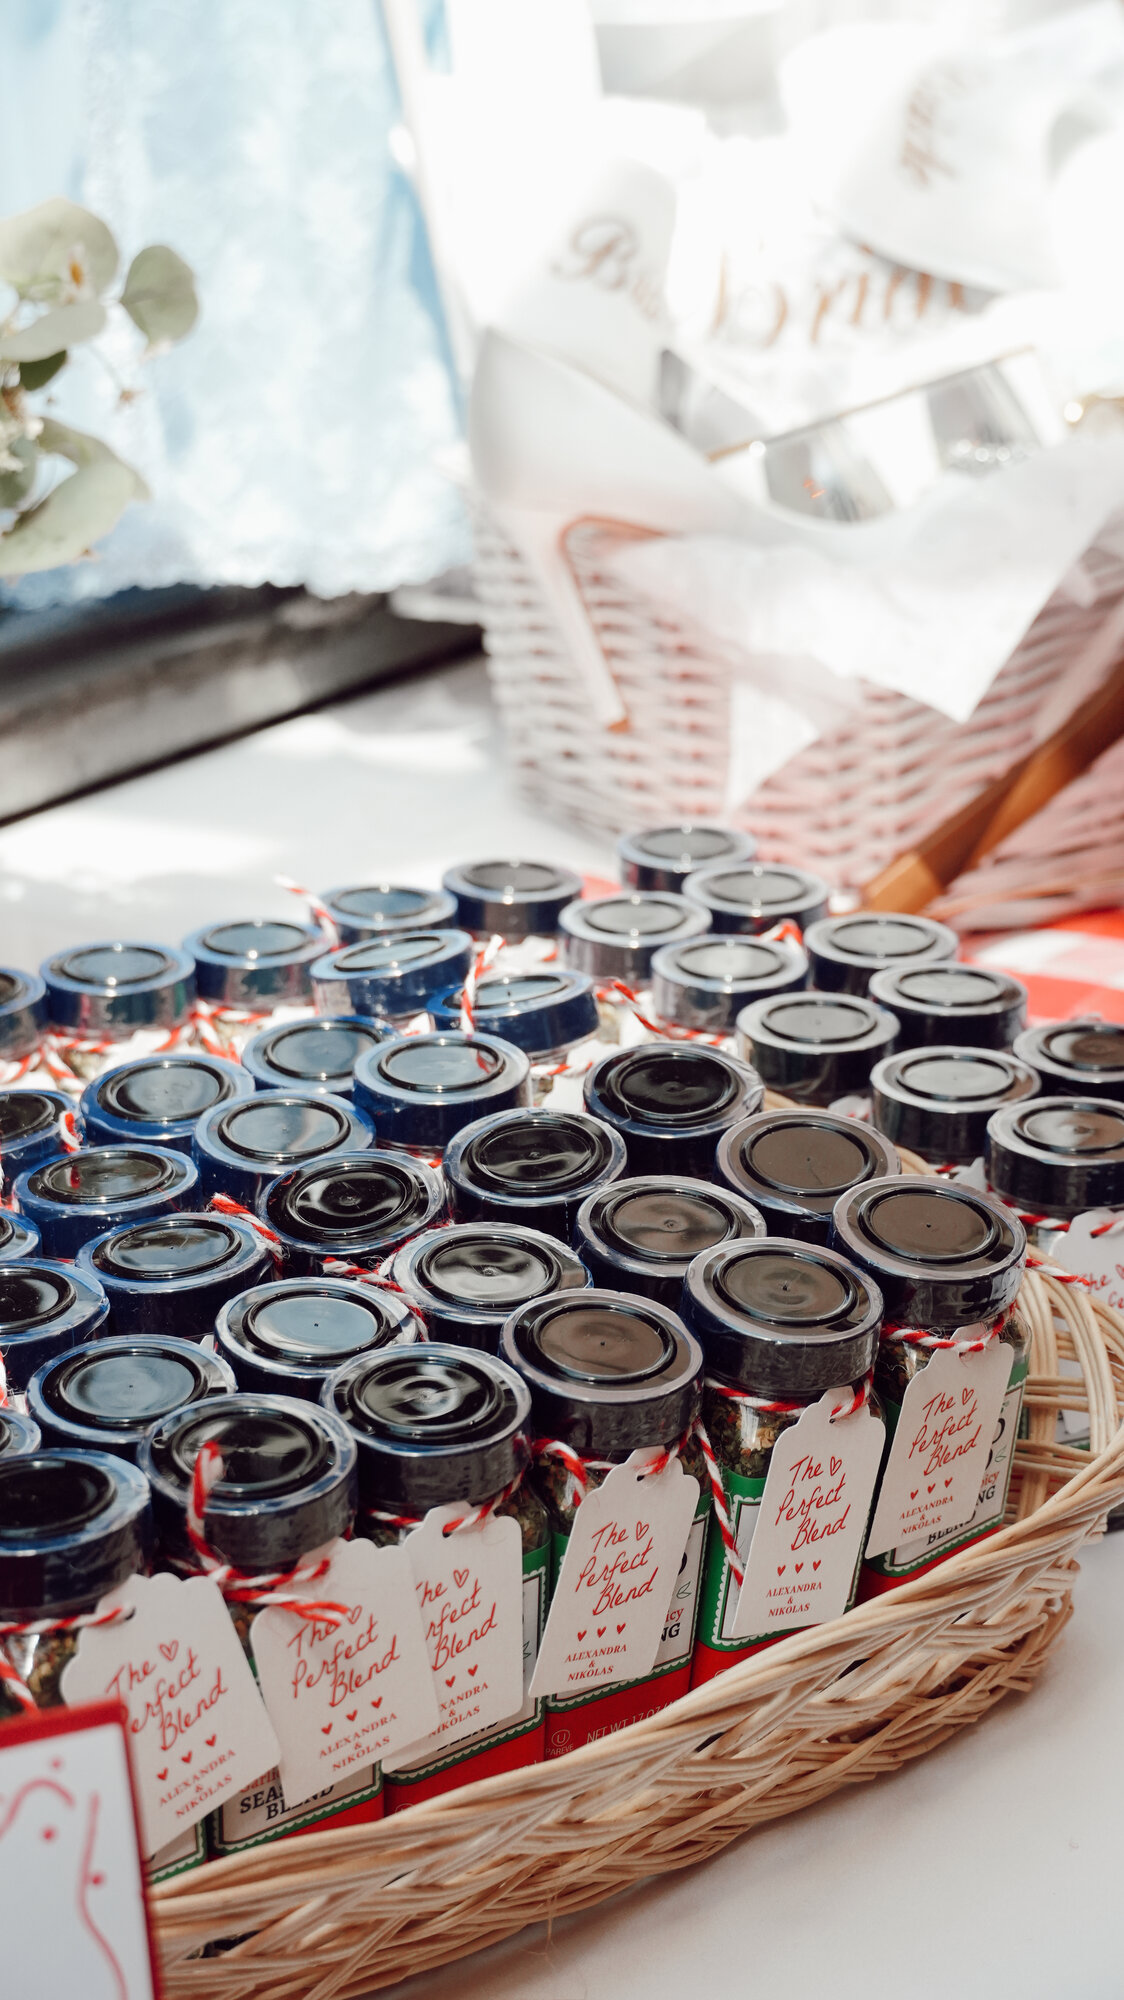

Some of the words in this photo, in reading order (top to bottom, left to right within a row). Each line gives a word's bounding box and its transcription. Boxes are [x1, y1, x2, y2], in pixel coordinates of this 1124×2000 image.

[922, 1392, 956, 1422] The
[908, 1399, 978, 1460] Perfect
[923, 1424, 983, 1477] Blend
[789, 1454, 824, 1487] The
[775, 1472, 846, 1529] Perfect
[899, 1495, 954, 1521] ALEXANDRA
[919, 1513, 926, 1521] &
[591, 1521, 629, 1553] The
[790, 1504, 852, 1551] Blend
[901, 1515, 942, 1536] NIKOLAS
[575, 1536, 654, 1597] Perfect
[592, 1566, 659, 1616] Blend
[766, 1581, 823, 1598] ALEXANDRA
[787, 1596, 794, 1605] &
[425, 1578, 482, 1648] rfect
[768, 1602, 811, 1618] NIKOLAS
[287, 1620, 339, 1658] The
[292, 1613, 378, 1699] Perfect
[431, 1602, 498, 1672] Blend
[564, 1643, 627, 1664] ALEXANDRA
[105, 1660, 157, 1698] The
[329, 1634, 401, 1708] Blend
[567, 1665, 614, 1682] NIKOLAS
[588, 1659, 596, 1668] &
[130, 1647, 202, 1734] erfect
[160, 1666, 229, 1751] Blend
[440, 1681, 489, 1713] XANDRA
[448, 1708, 456, 1718] &
[319, 1712, 398, 1760] ALEXANDRA
[332, 1735, 391, 1772] NIKOLAS
[354, 1741, 362, 1750] &
[158, 1749, 237, 1807] ALEXANDRA
[175, 1774, 233, 1818] NIKOLAS
